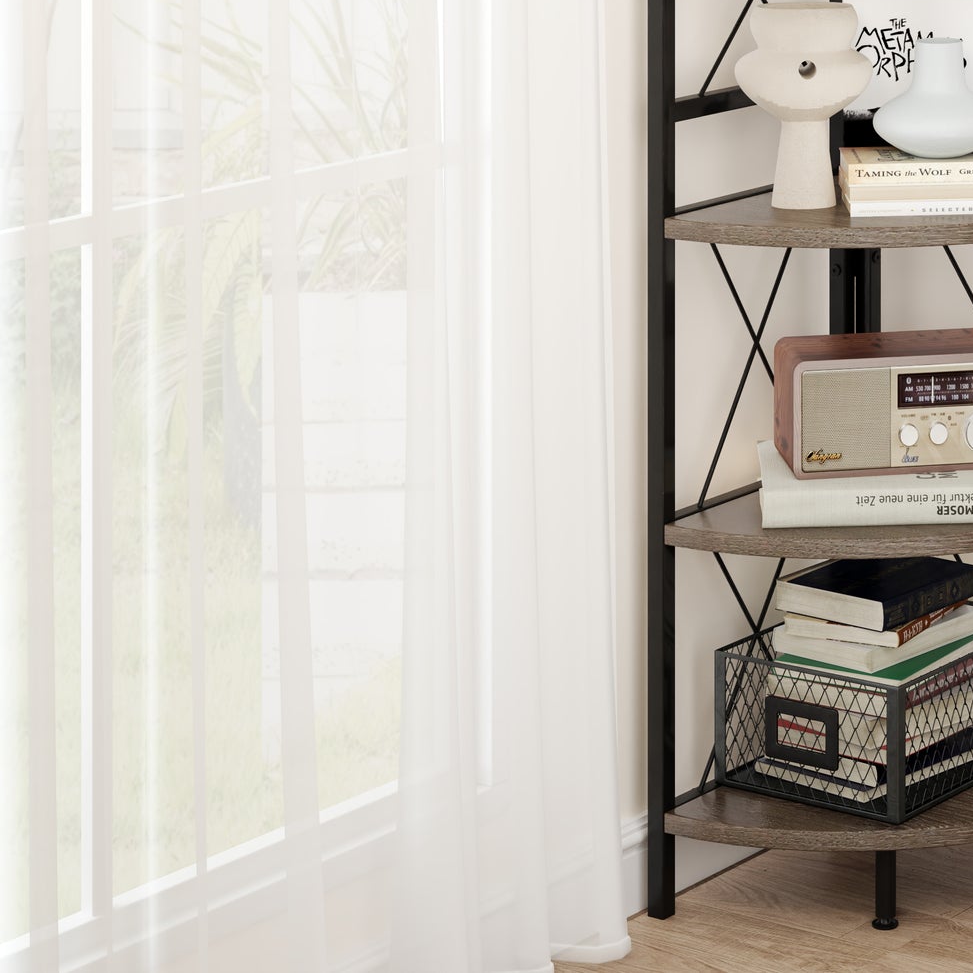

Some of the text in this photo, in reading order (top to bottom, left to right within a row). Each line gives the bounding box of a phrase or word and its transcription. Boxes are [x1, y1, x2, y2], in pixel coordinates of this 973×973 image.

[889, 18, 907, 30] THE
[854, 169, 902, 178] TAMING
[919, 167, 952, 177] WOLF
[855, 495, 876, 507] Zeit
[879, 495, 904, 504] neue
[906, 494, 929, 506] eine
[931, 493, 947, 504] für
[936, 505, 973, 516] MOSER
